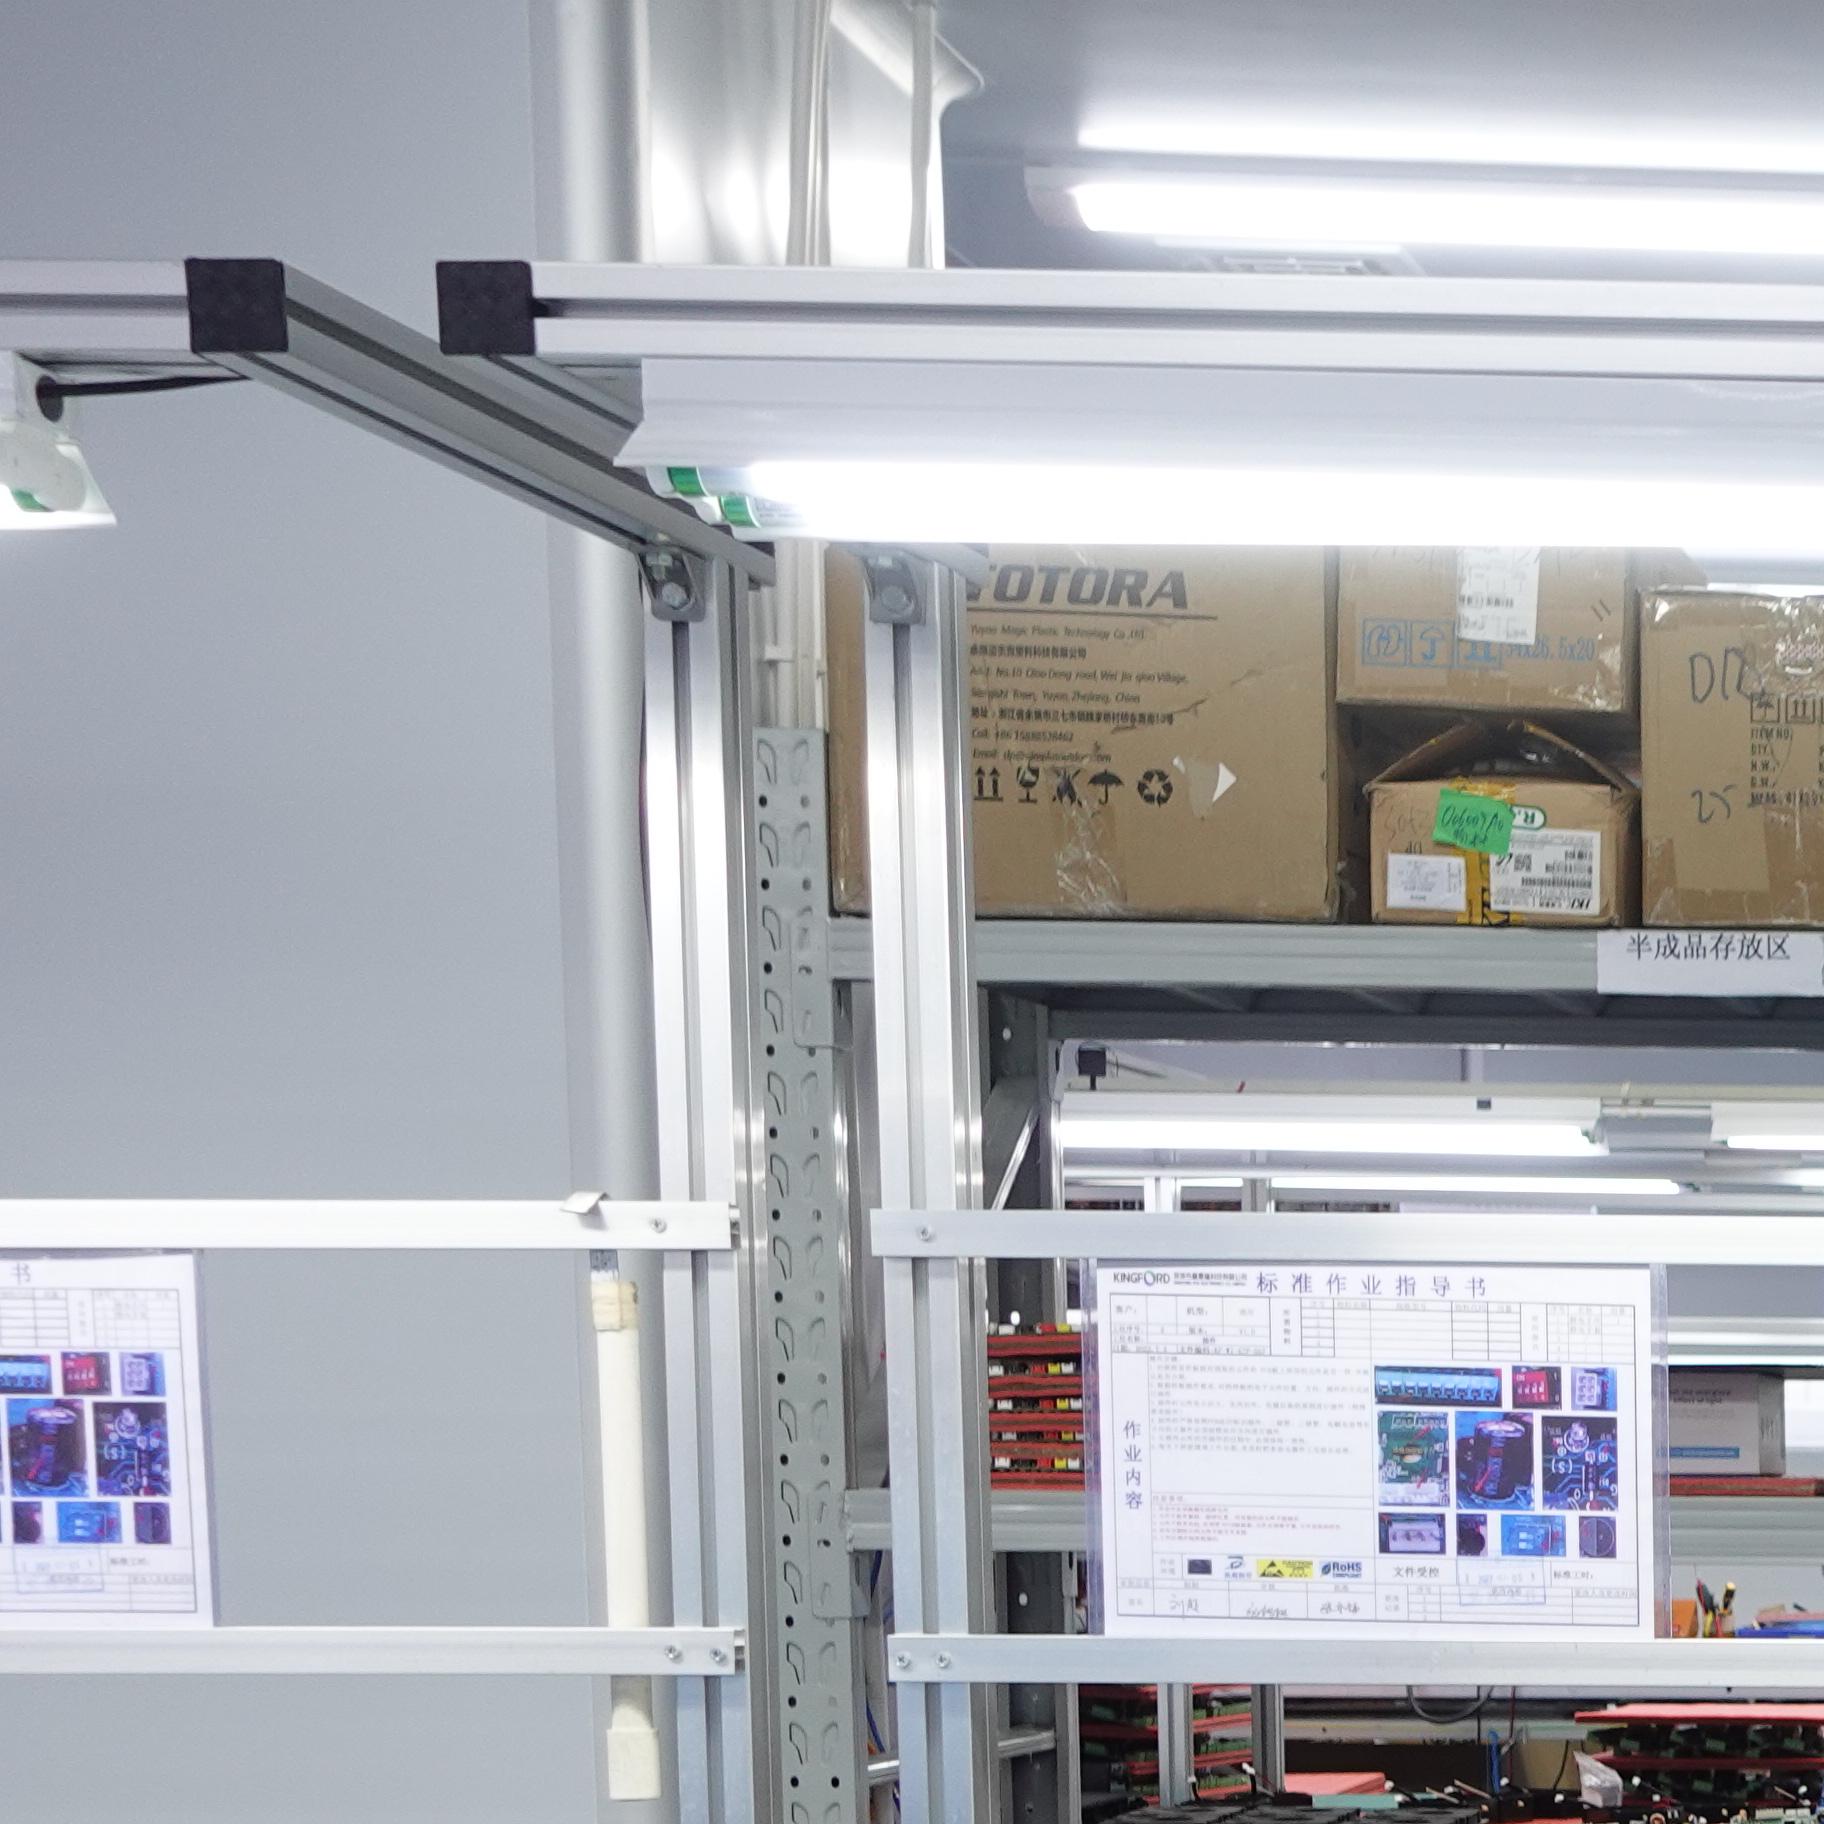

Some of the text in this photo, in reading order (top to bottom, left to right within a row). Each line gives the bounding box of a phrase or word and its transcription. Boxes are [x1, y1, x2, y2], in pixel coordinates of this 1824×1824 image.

[1626, 933, 1791, 961] 半成品存放区
[11, 1262, 31, 1284] 书
[1113, 1270, 1170, 1286] KINGFORD
[1256, 1272, 1487, 1298] 标准作业指导书
[1123, 1419, 1143, 1511] 作业内容
